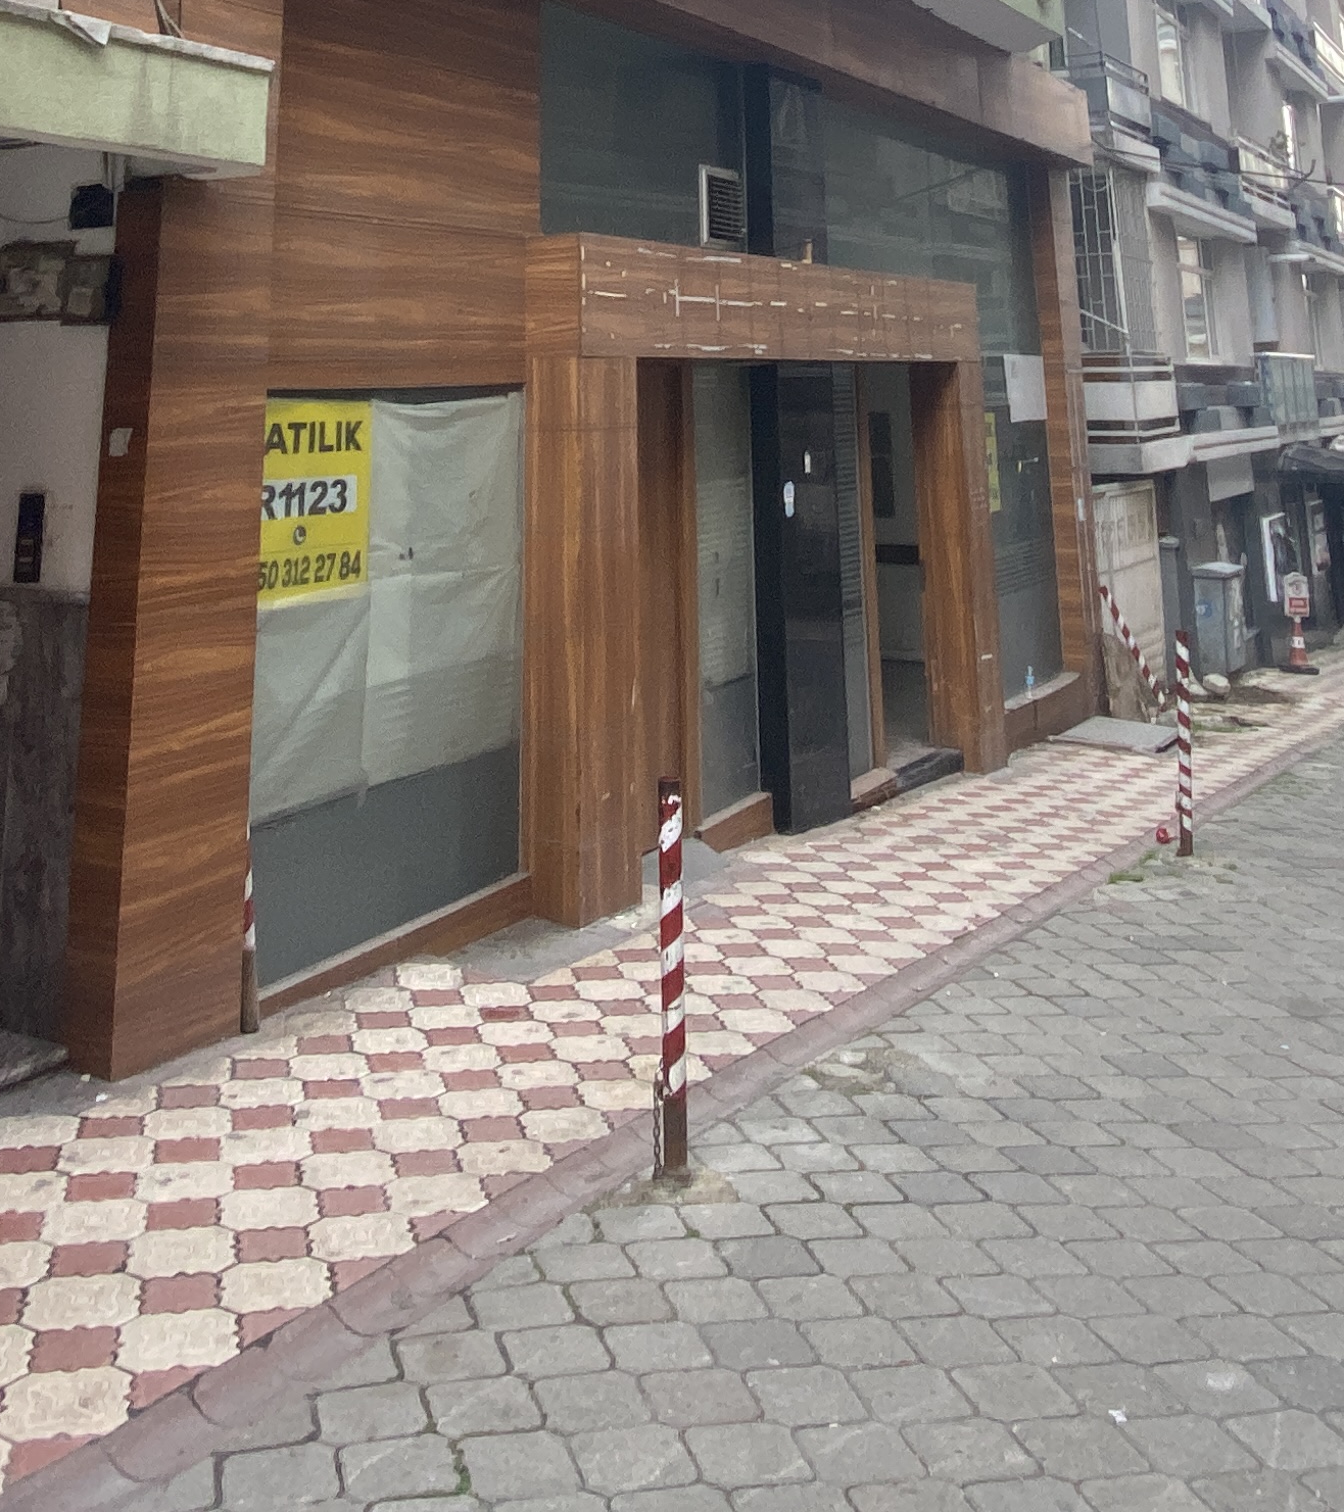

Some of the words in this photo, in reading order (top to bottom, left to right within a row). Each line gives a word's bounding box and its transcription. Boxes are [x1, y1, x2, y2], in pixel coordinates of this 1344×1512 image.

[282, 555, 311, 588] 312
[314, 552, 337, 583] 27
[339, 550, 362, 581] 84
